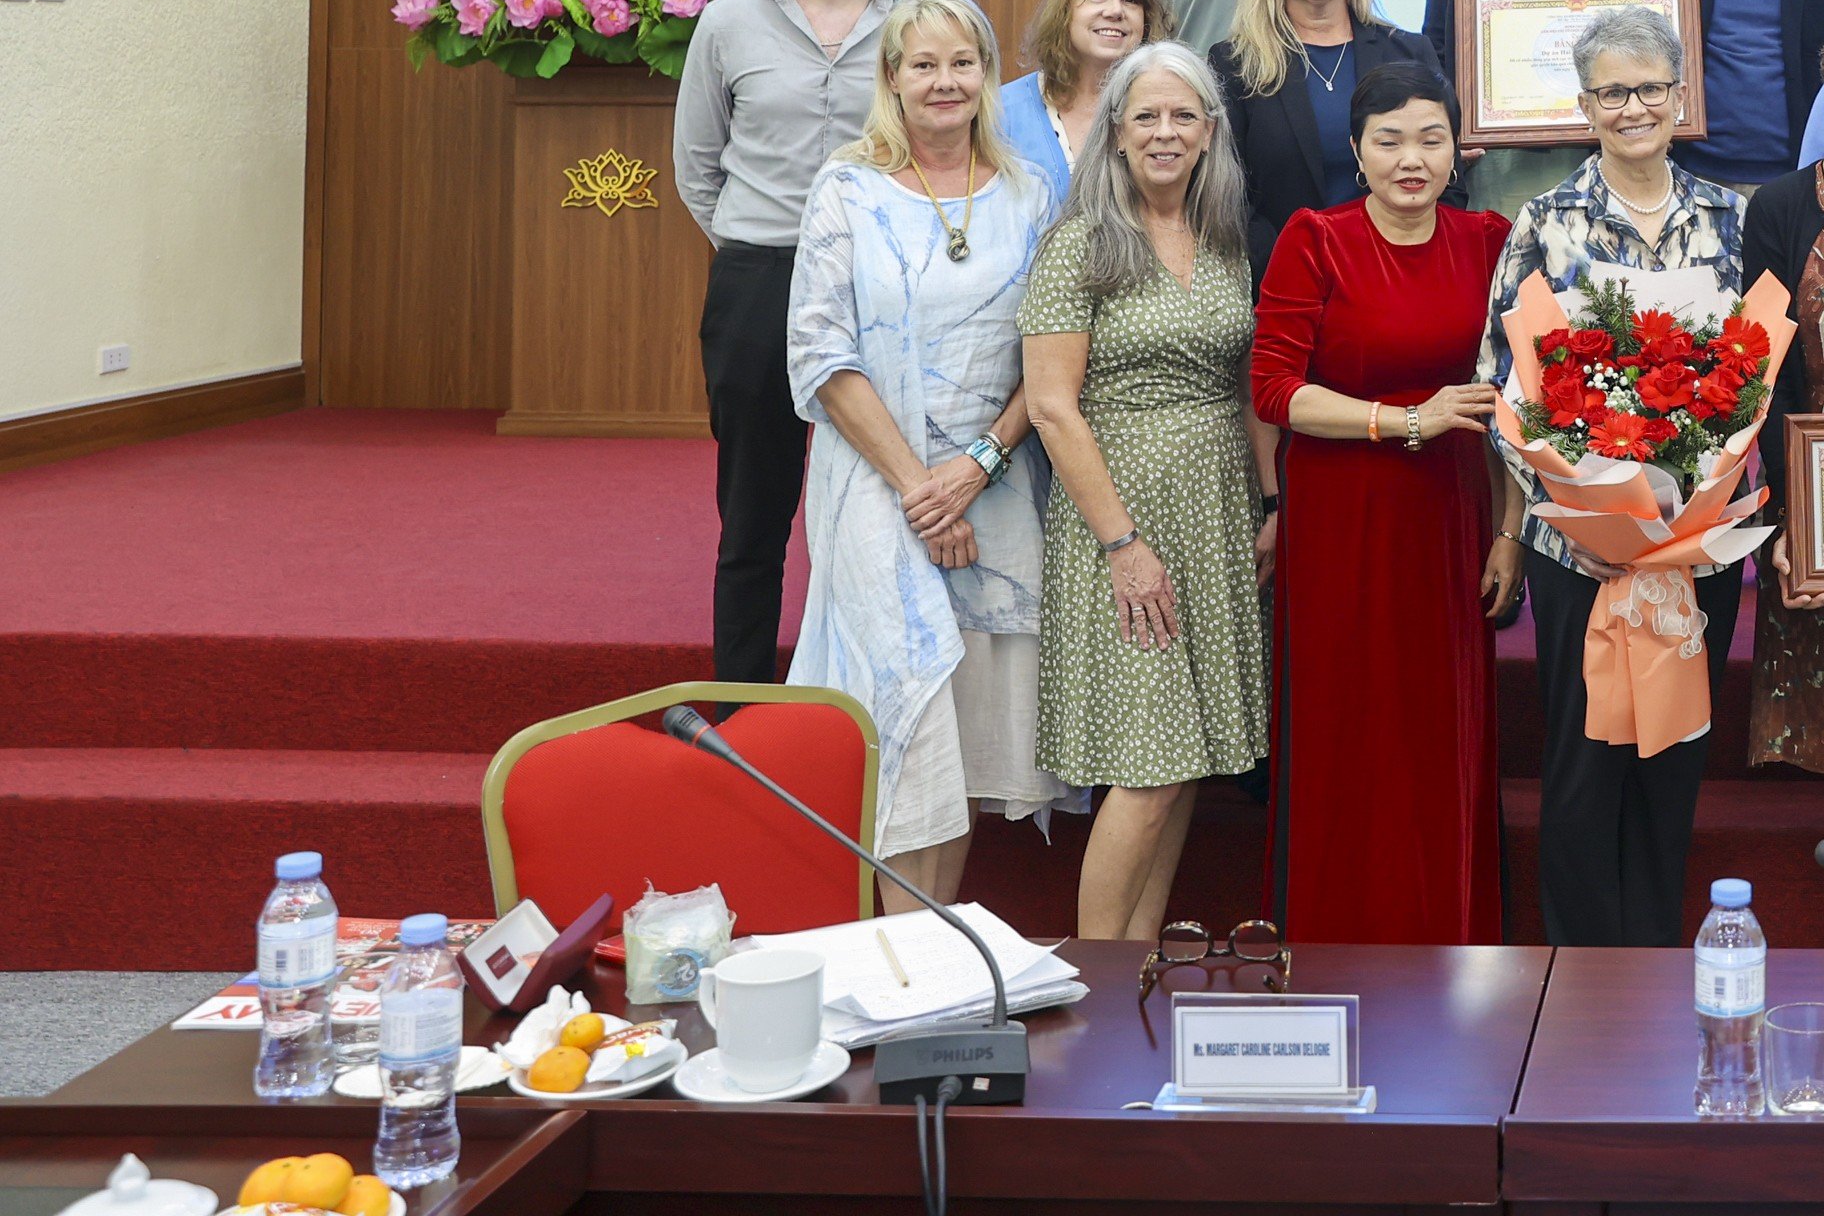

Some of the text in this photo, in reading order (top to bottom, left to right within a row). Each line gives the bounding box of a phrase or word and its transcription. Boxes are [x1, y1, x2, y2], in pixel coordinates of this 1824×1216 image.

[932, 1047, 994, 1063] PHILIPS
[1206, 1043, 1239, 1056] MARGARET
[1241, 1043, 1271, 1056] CAROLINE
[1272, 1043, 1301, 1056] CARLSON
